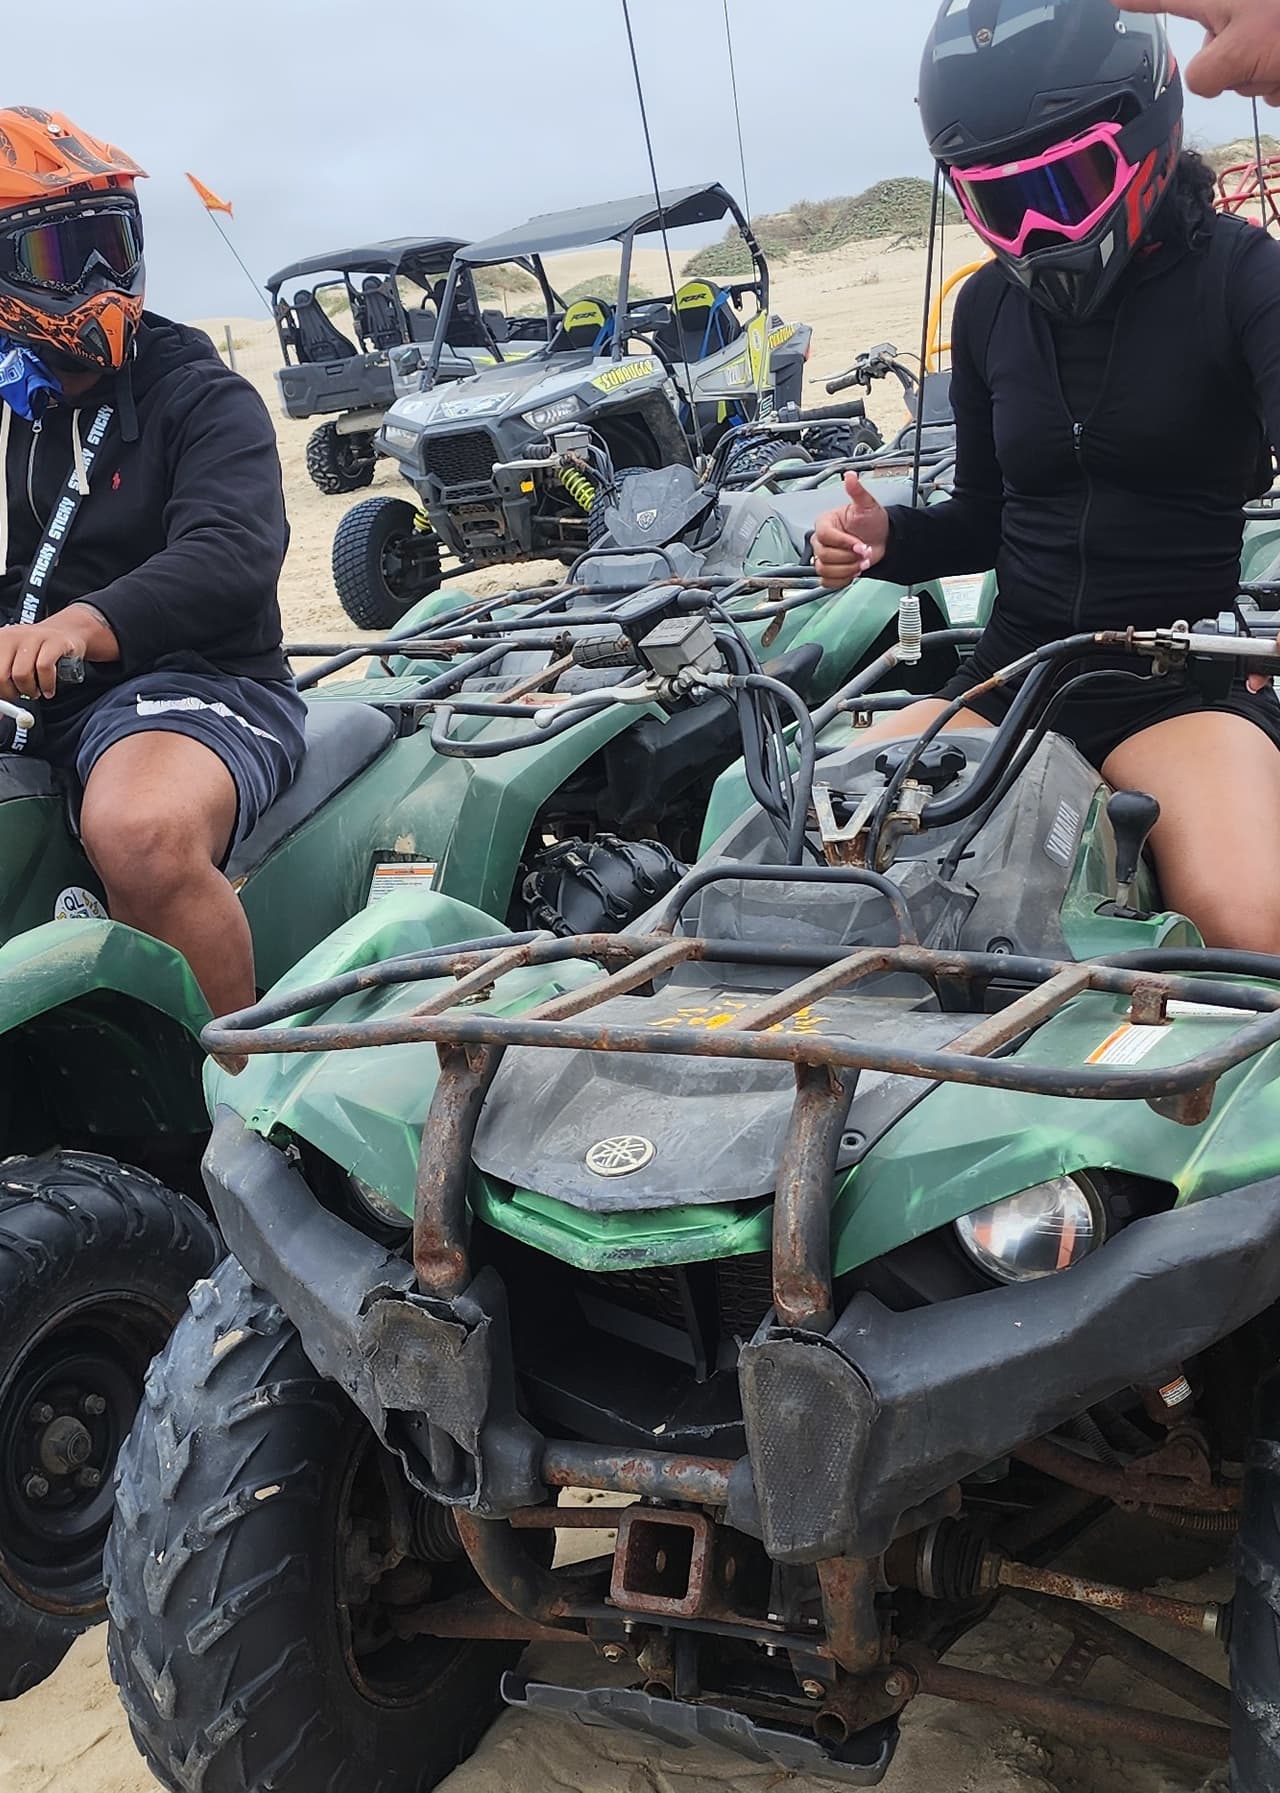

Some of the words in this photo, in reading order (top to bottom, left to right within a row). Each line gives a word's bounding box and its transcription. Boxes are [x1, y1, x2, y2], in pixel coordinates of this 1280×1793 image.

[87, 404, 114, 446] STICKY
[48, 497, 76, 540] STICKY
[30, 543, 57, 588] STICKY
[20, 592, 40, 624] ICKY
[1046, 800, 1080, 860] YAMAHA
[63, 890, 85, 911] QL
